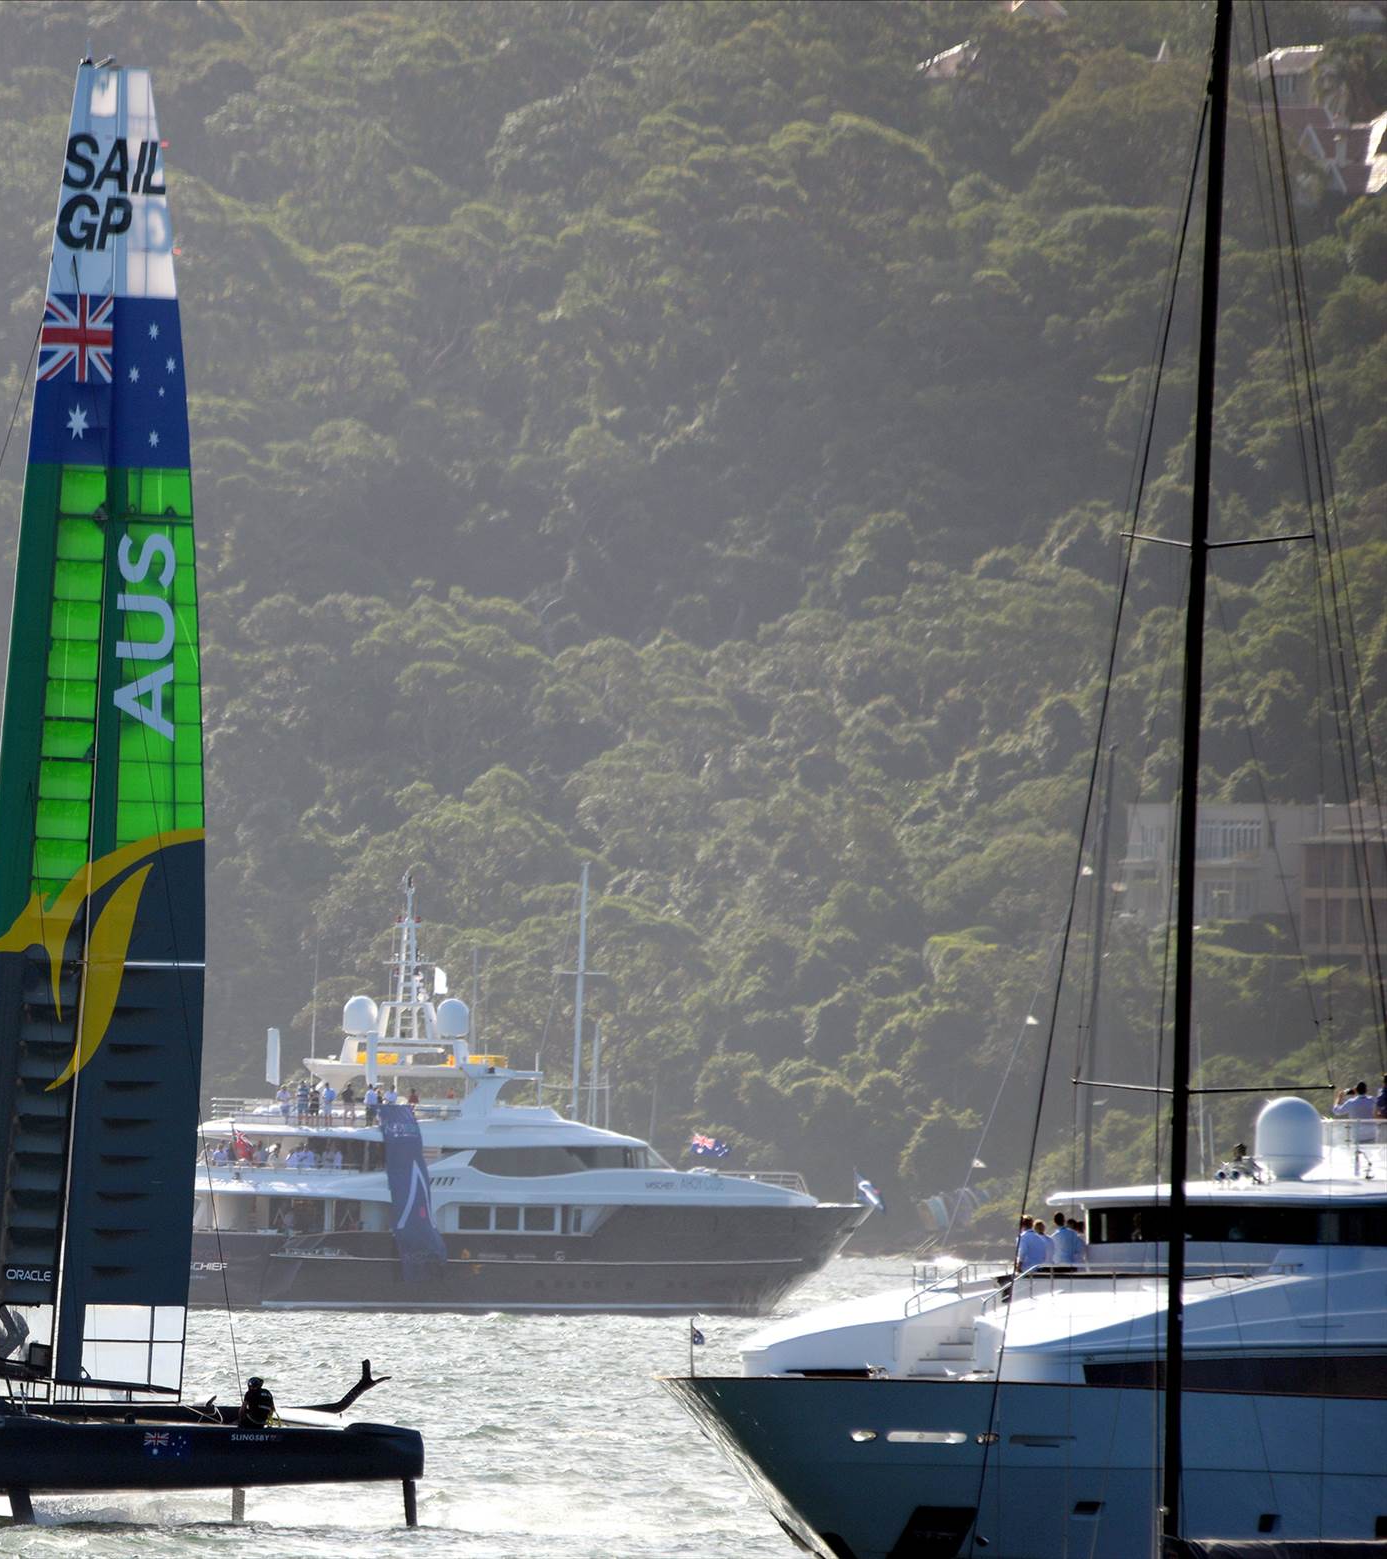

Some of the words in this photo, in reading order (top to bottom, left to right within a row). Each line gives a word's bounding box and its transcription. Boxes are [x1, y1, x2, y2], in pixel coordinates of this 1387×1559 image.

[63, 133, 166, 195] SAIL
[57, 193, 133, 251] GP
[113, 532, 176, 743] AUS
[6, 1269, 52, 1282] ORACLE
[231, 1433, 270, 1441] SLINGSBY
